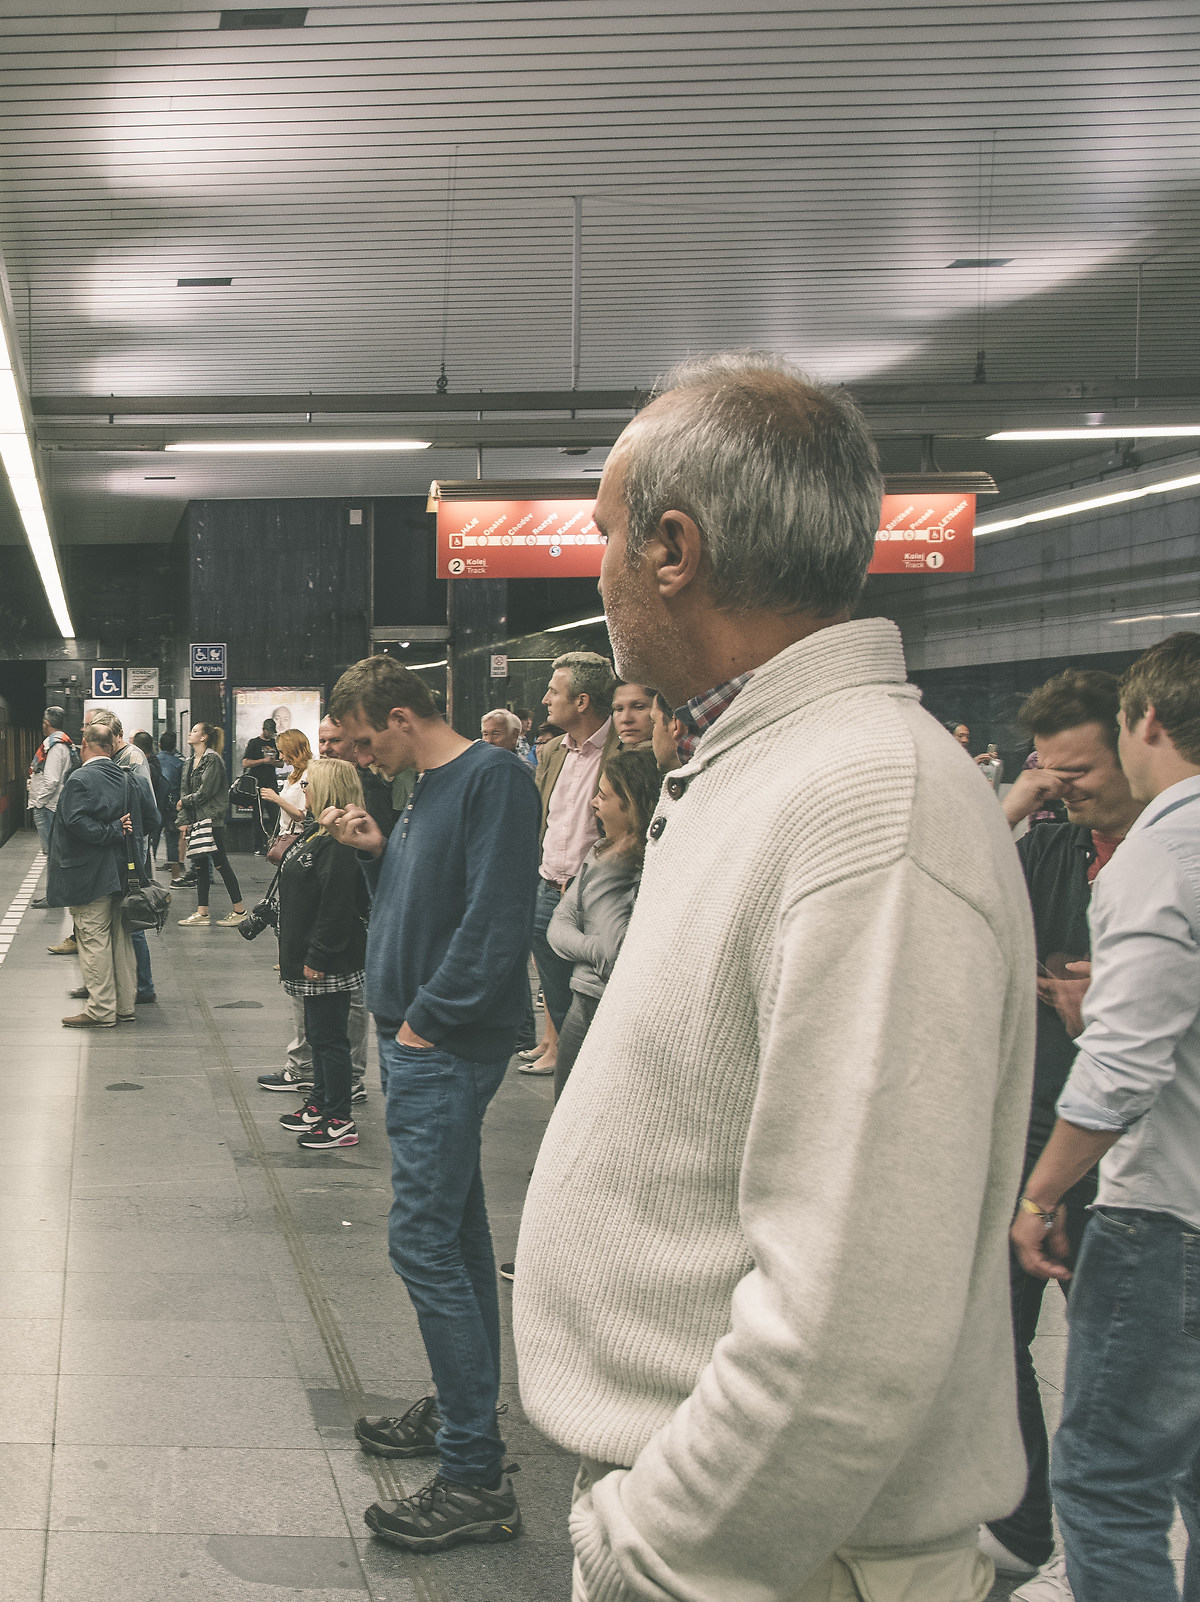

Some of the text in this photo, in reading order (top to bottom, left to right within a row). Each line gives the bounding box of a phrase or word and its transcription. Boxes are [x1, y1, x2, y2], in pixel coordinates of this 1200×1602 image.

[483, 514, 508, 536] Opatov
[508, 512, 534, 536] Chodov
[532, 512, 558, 535] Roztyly
[944, 529, 956, 540] C
[453, 560, 461, 572] 2
[466, 558, 486, 566] Kolej
[904, 561, 925, 569] Track
[931, 554, 937, 566] 1
[237, 693, 265, 705] BILL
